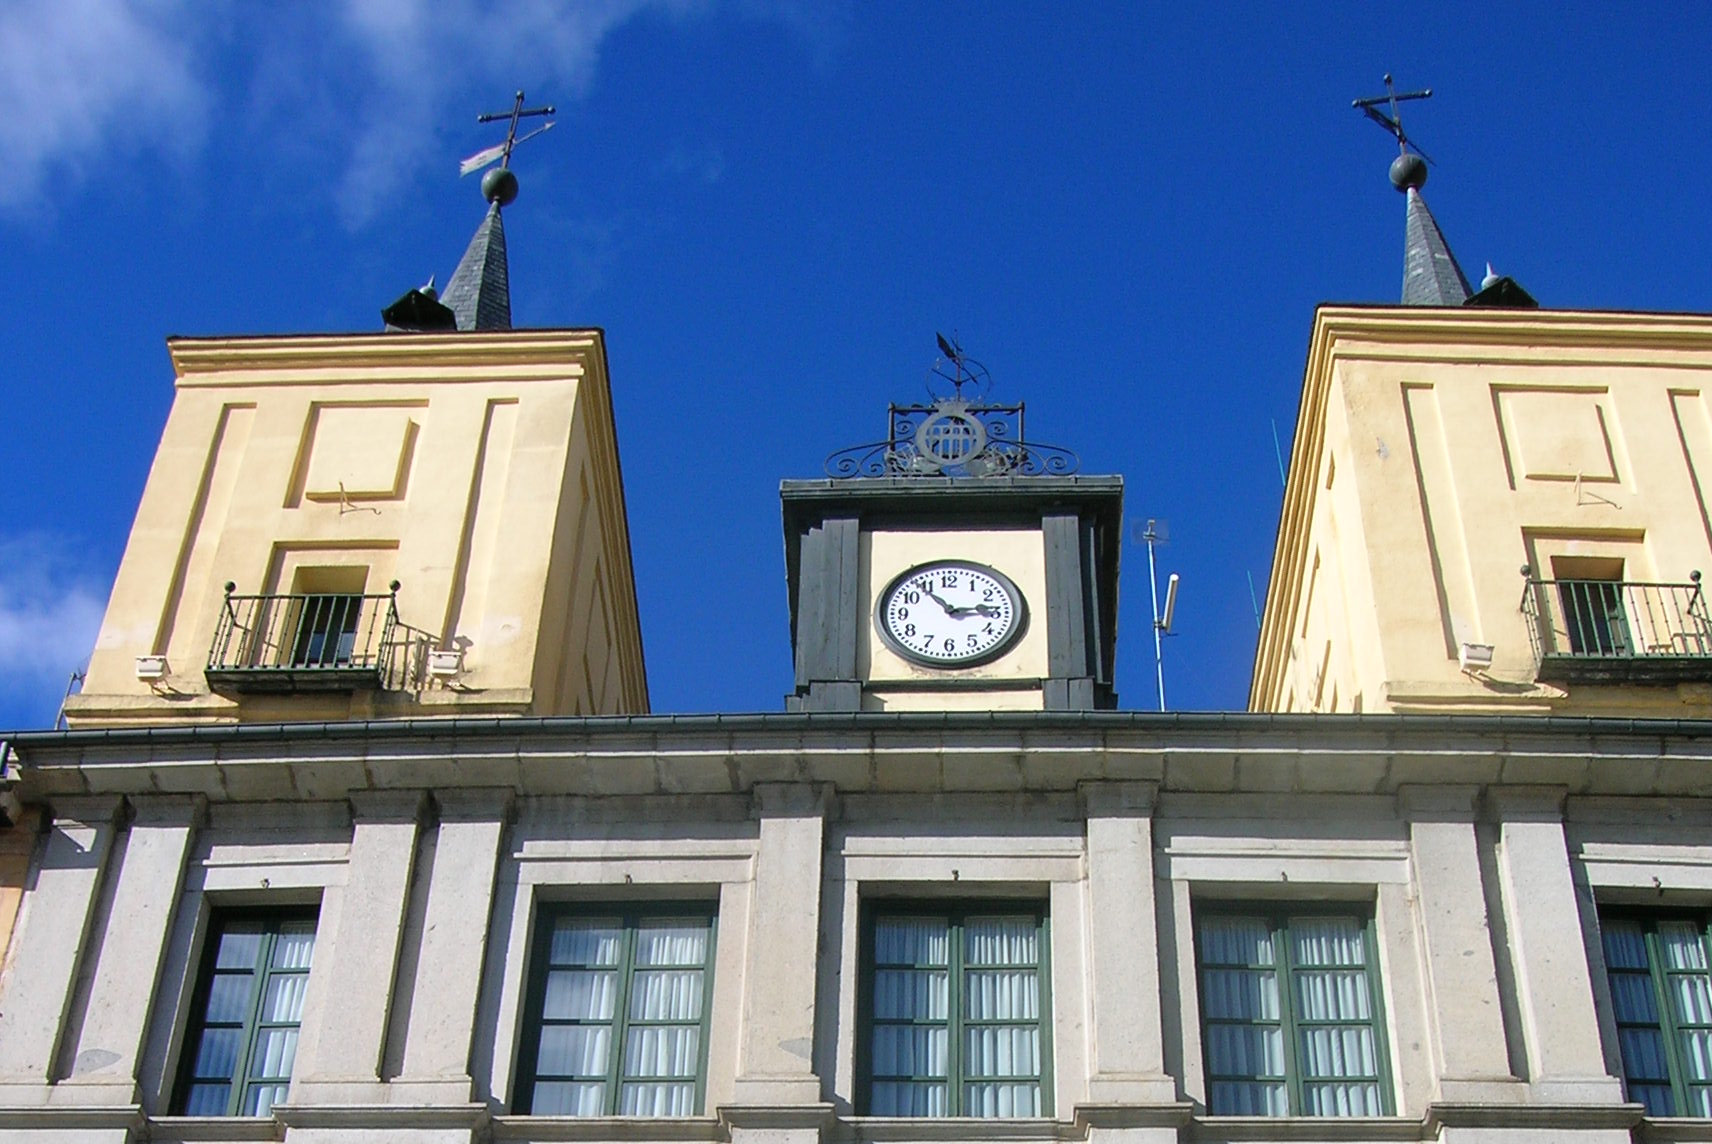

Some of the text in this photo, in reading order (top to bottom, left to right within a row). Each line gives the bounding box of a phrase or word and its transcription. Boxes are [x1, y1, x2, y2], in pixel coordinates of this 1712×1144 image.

[941, 575, 958, 589] 12
[969, 579, 976, 592] 1
[904, 592, 920, 605] 10
[983, 589, 994, 602] 2
[898, 607, 909, 621] 9
[904, 623, 916, 637] 8
[981, 622, 995, 636] 4
[924, 635, 935, 648] 7
[944, 638, 955, 652] 6
[967, 634, 978, 648] 5
